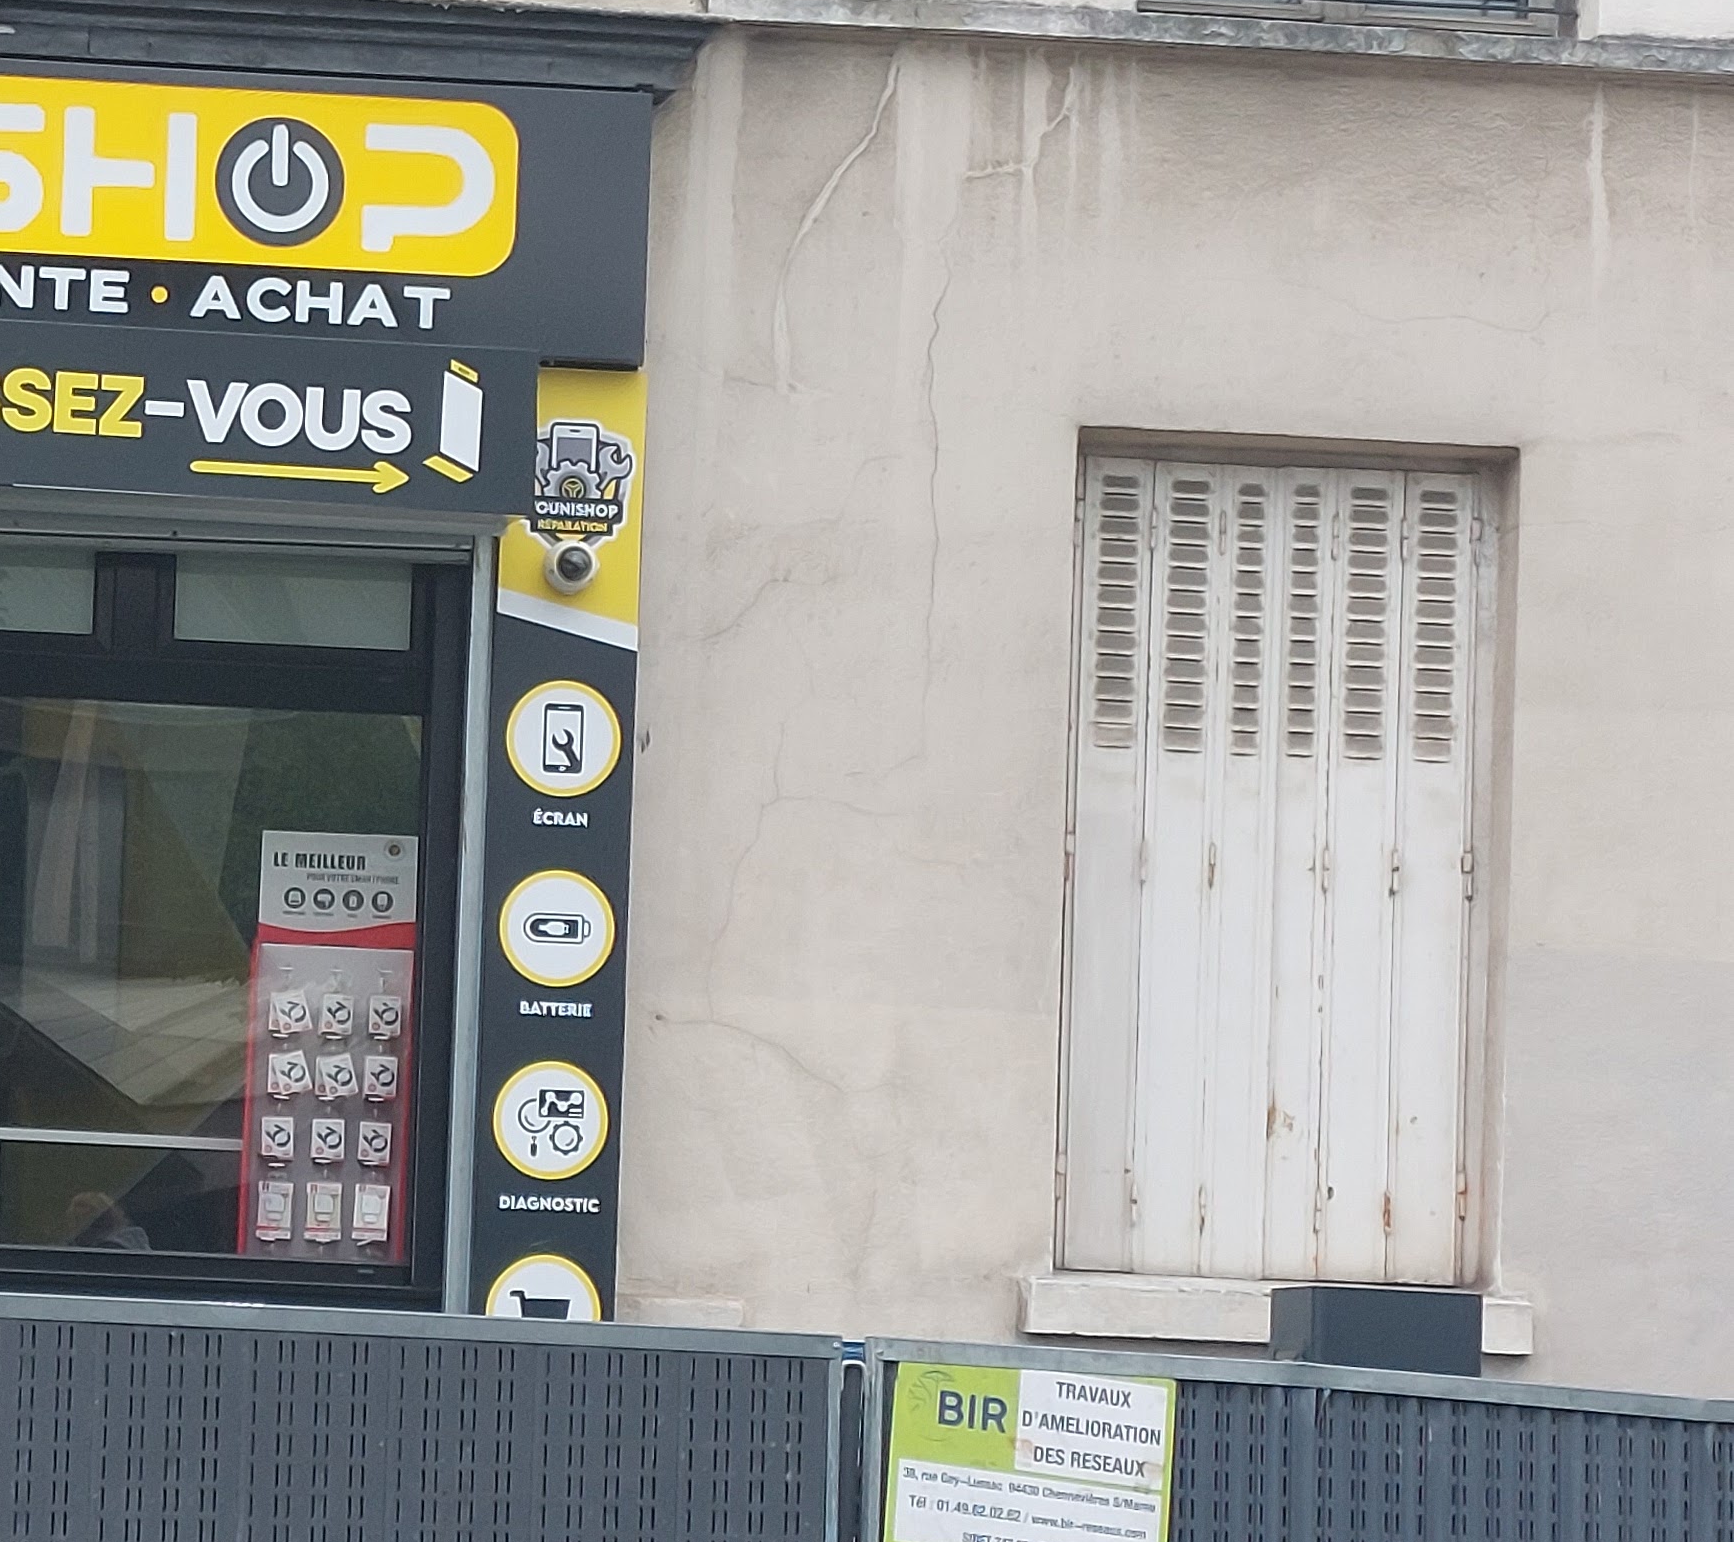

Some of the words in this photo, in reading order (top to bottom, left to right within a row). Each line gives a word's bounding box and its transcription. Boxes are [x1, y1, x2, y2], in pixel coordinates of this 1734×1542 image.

[190, 276, 451, 329] ACHAT
[535, 500, 619, 519] OUNISHOP
[533, 809, 589, 828] ÉCRAN
[273, 851, 289, 867] LE
[519, 1000, 593, 1018] BATTERIE
[498, 1194, 601, 1214] DIAGNOSTIC
[1055, 1381, 1132, 1408] TRAVAUX
[937, 1389, 1008, 1434] BIR
[1022, 1410, 1161, 1446] D'AMELIORATION
[1033, 1445, 1065, 1466] DES
[1071, 1451, 1146, 1478] RESEAUX
